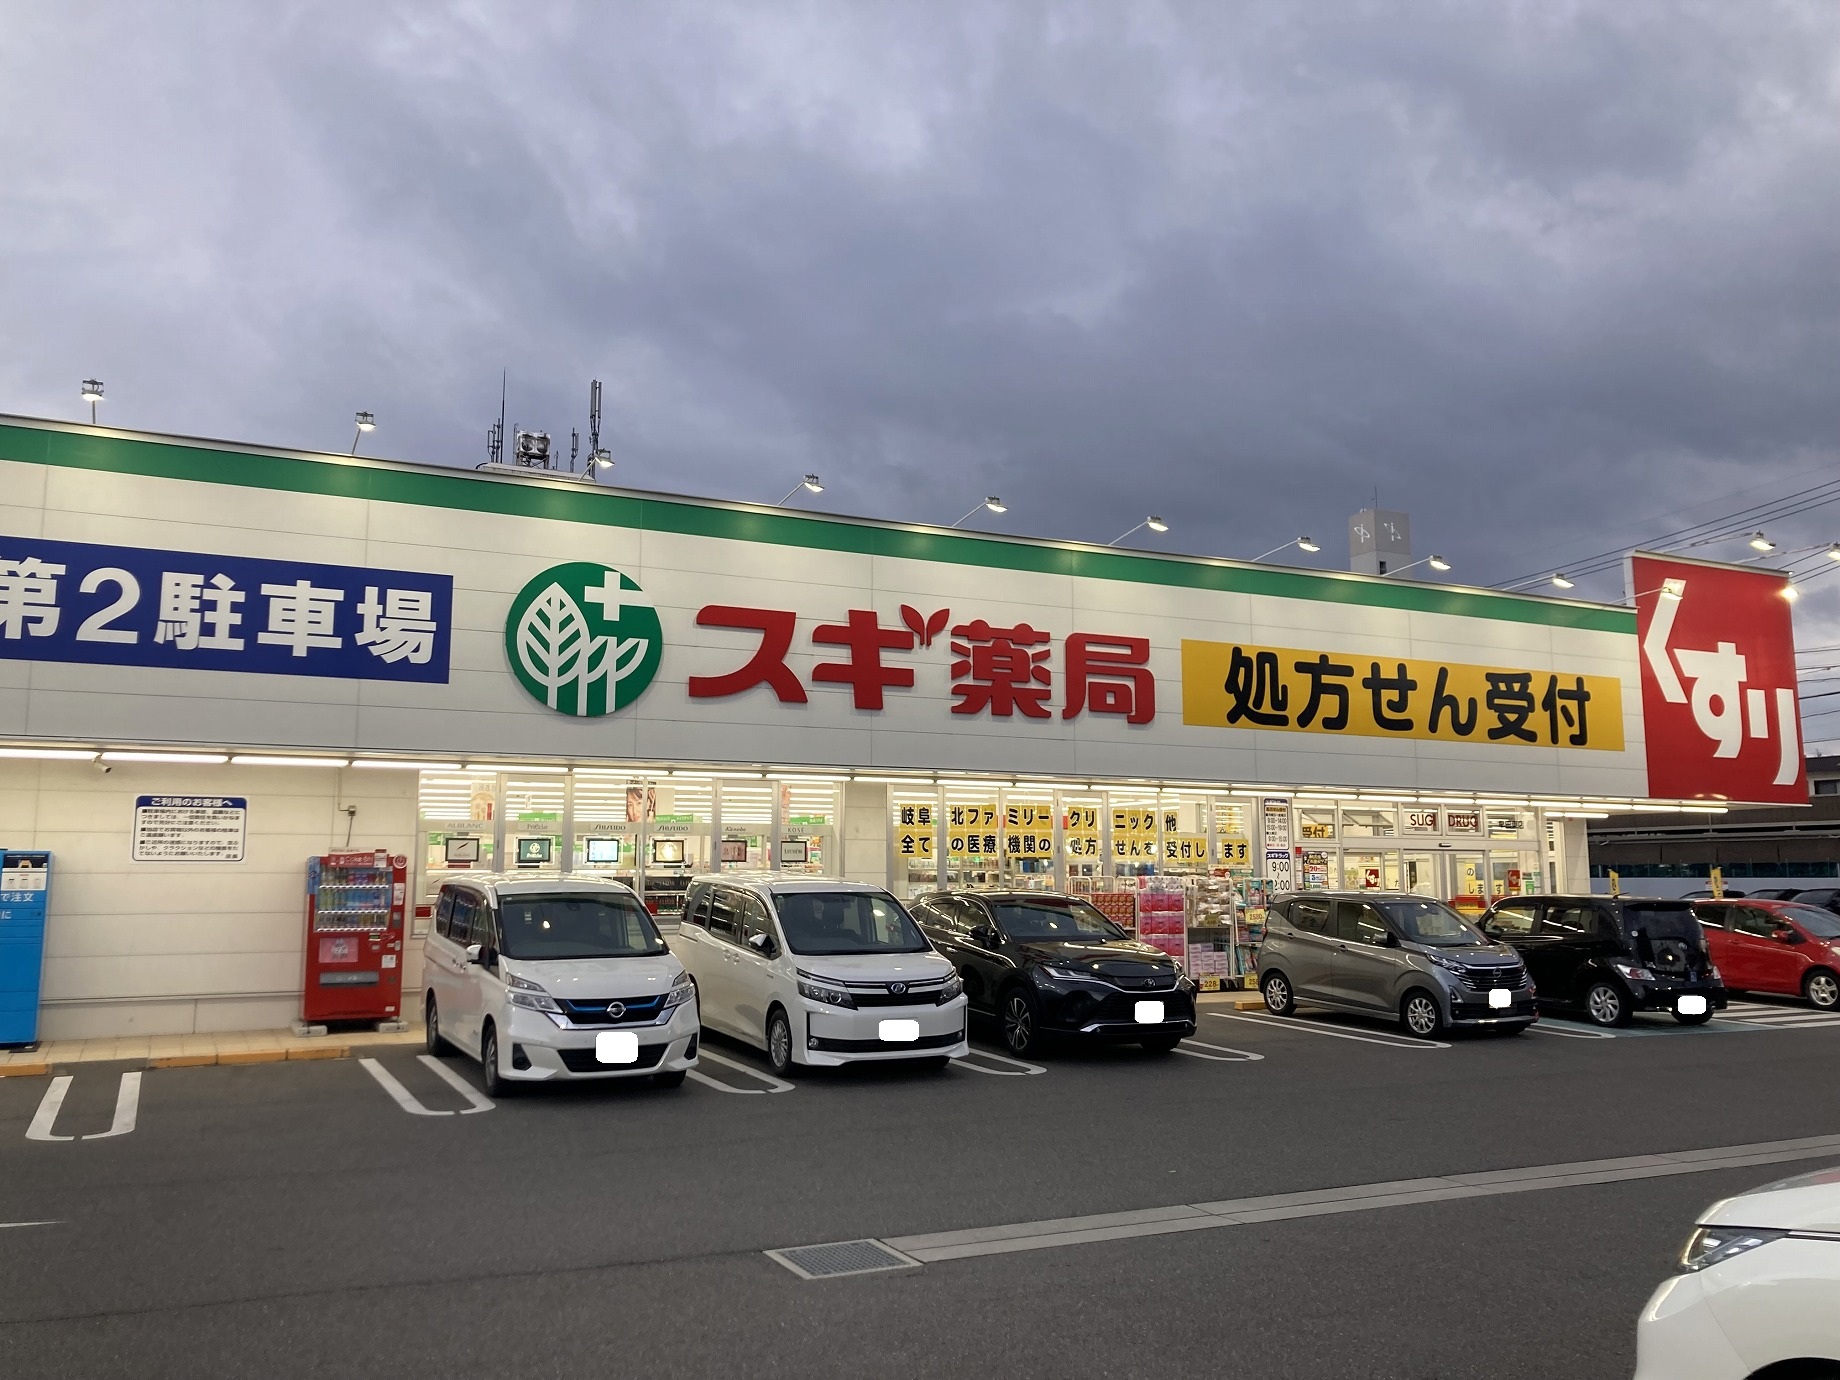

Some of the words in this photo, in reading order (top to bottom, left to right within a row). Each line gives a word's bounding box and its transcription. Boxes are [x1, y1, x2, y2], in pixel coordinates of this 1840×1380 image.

[0, 556, 437, 665] 第2駐車場
[688, 604, 1156, 725] スギ薬局
[1643, 577, 1800, 786] くすり
[1223, 645, 1591, 747] 処方せん受付
[1448, 815, 1478, 827] DRUG
[1272, 861, 1290, 872] 9:00
[1467, 868, 1474, 876] の
[1274, 880, 1290, 891] 2:00
[0, 892, 34, 902] で注文
[1, 910, 12, 919] に
[1204, 980, 1217, 988] 228
